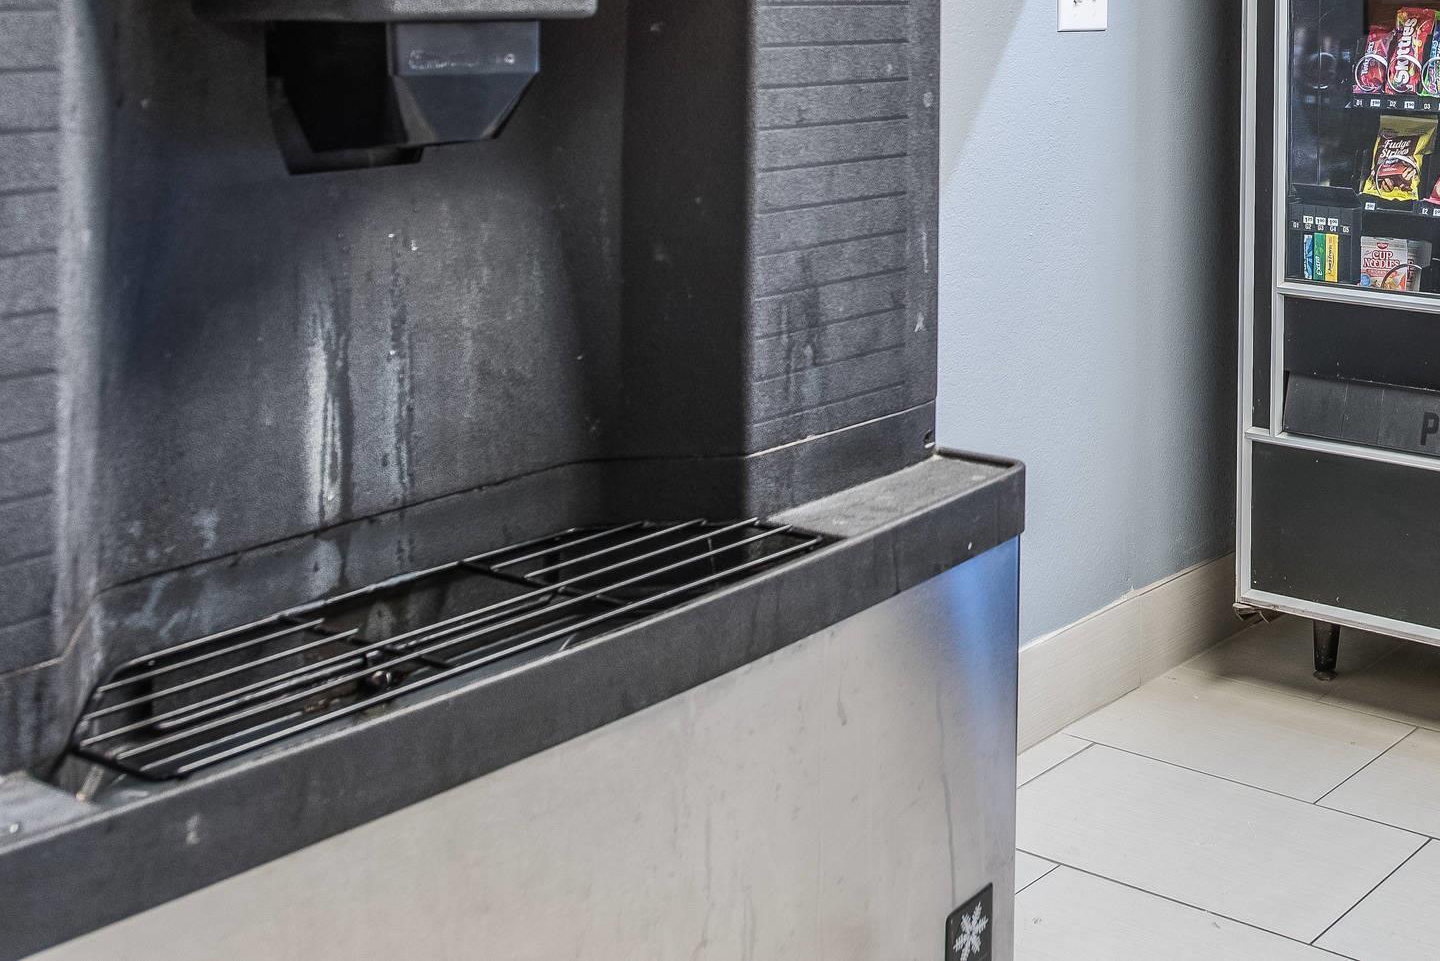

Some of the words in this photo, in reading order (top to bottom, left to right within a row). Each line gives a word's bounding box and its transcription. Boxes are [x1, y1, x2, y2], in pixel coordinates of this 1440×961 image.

[1383, 139, 1411, 149] Fudge
[1372, 250, 1393, 259] CUP
[1363, 258, 1400, 268] NOODLES
